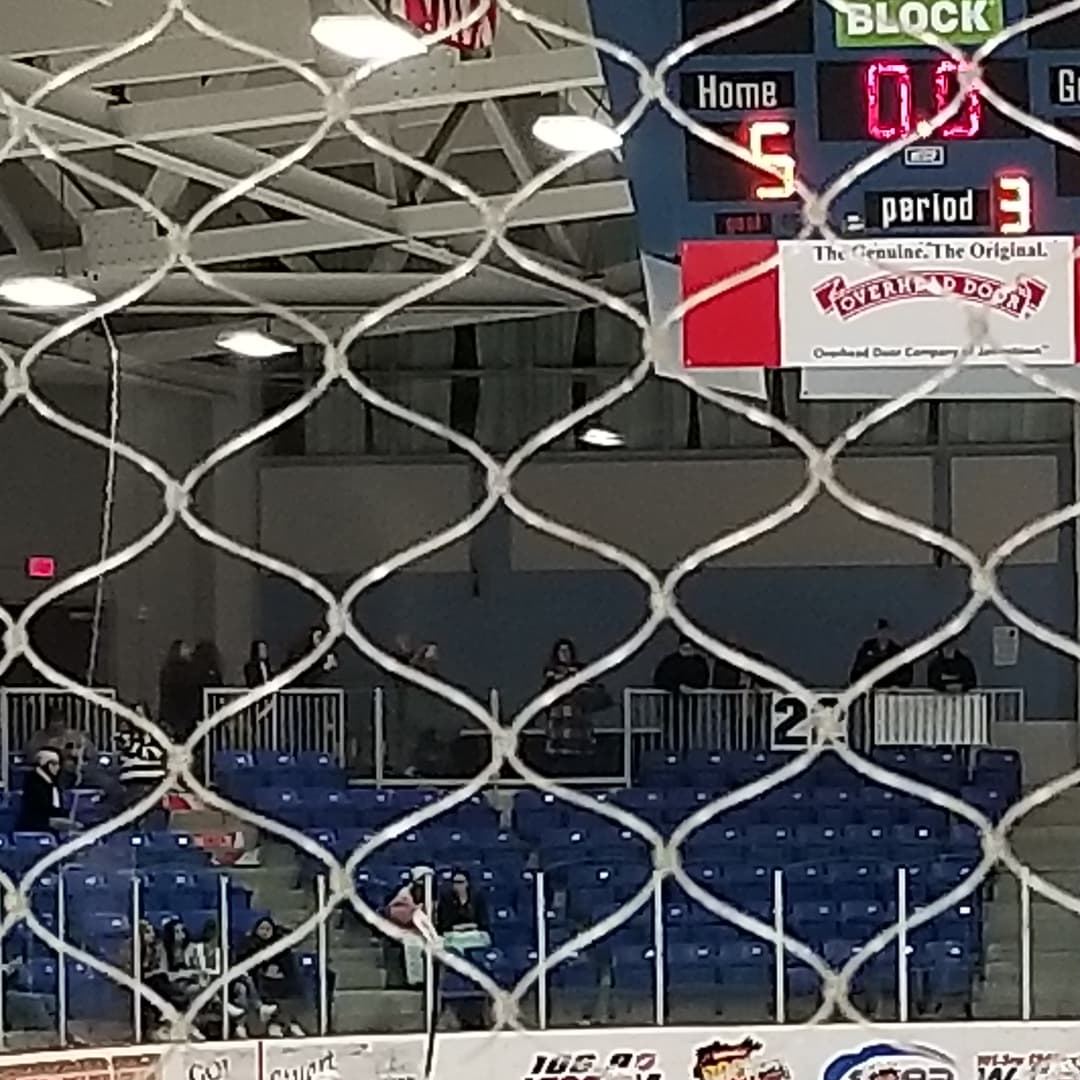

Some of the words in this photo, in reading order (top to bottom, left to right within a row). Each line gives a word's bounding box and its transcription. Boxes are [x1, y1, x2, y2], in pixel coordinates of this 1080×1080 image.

[847, 0, 991, 34] BLOCK
[699, 75, 777, 108] Home
[749, 121, 796, 199] 5
[881, 190, 974, 229] period
[999, 176, 1032, 235] 3
